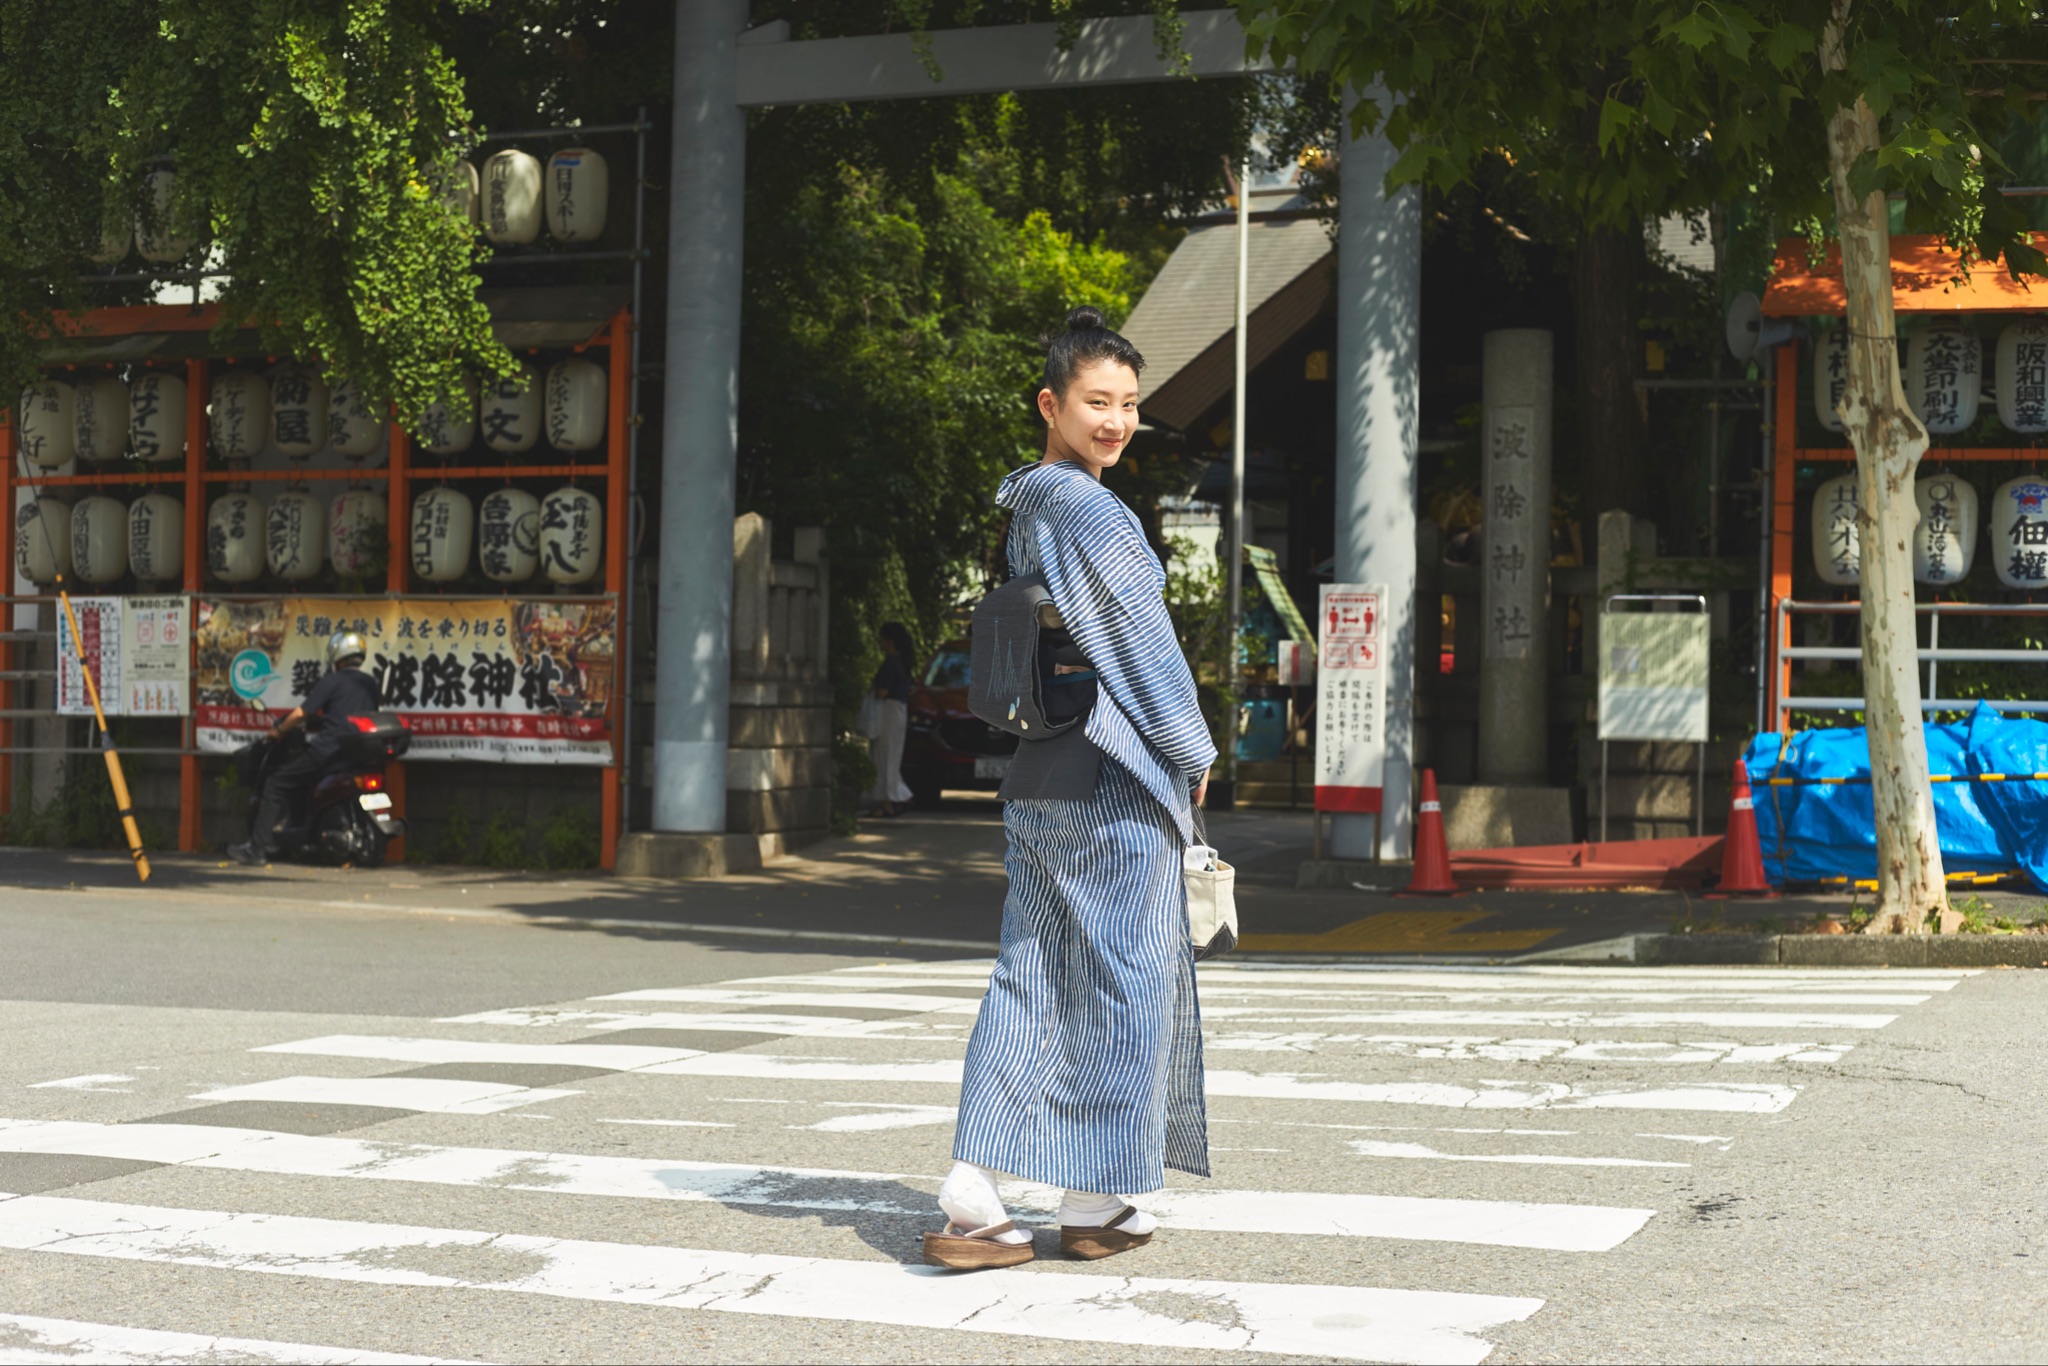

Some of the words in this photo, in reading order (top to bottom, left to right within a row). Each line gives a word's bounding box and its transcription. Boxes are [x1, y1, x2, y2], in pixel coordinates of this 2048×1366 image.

[2015, 343, 2047, 427] 阪和興業
[482, 495, 512, 575] 吉野家
[1493, 424, 1529, 643] 波除神社
[398, 617, 507, 639] 波を乗り切る
